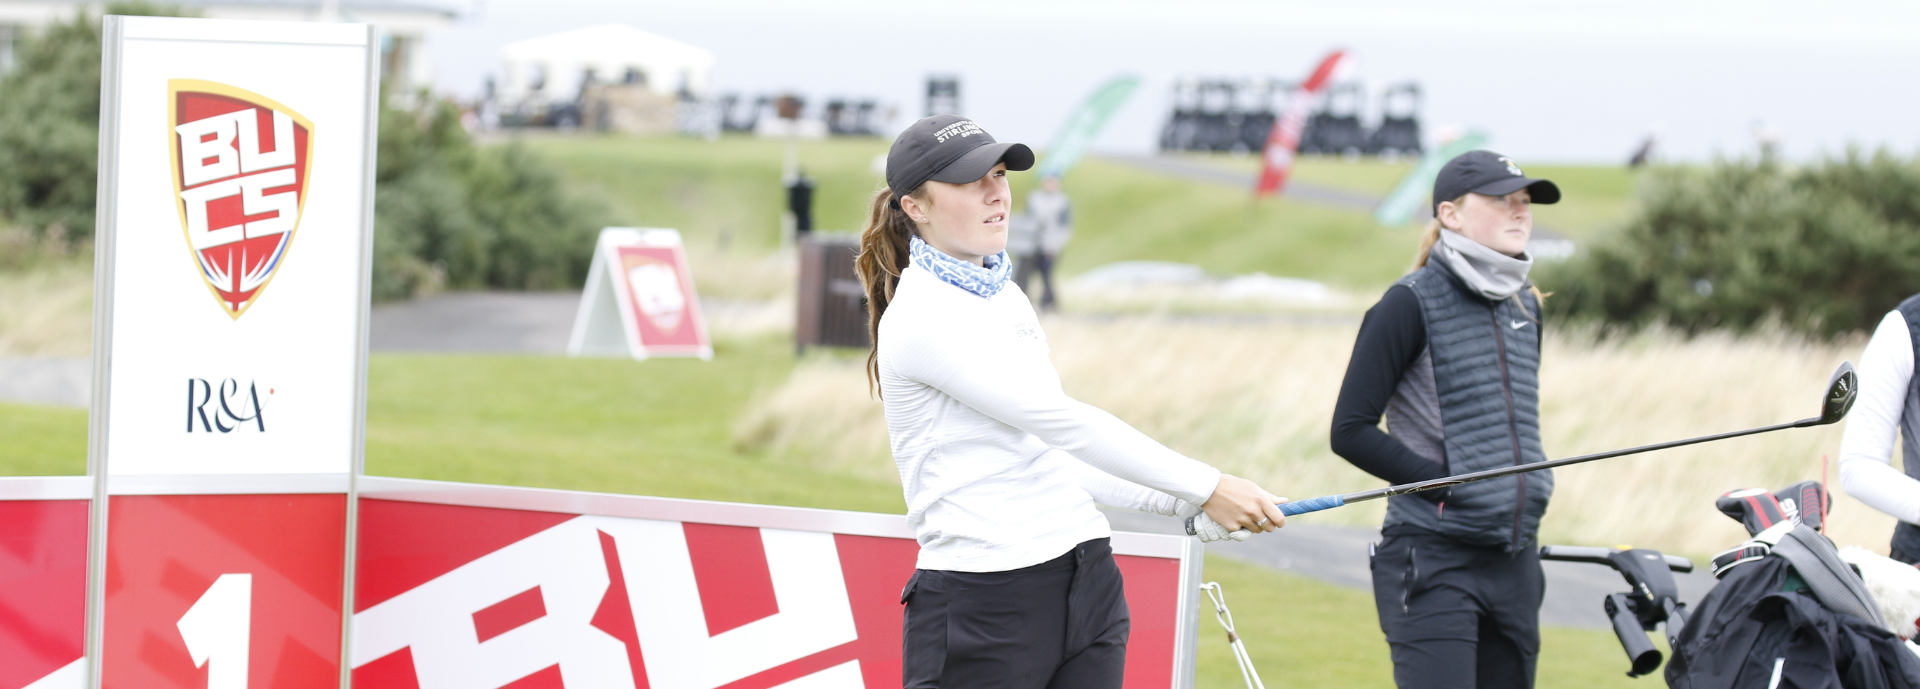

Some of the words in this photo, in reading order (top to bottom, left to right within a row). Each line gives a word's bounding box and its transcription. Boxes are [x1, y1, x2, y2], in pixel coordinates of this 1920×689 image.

[174, 108, 297, 187] BU
[179, 167, 299, 251] CS
[186, 377, 274, 433] R&A
[1780, 497, 1801, 529] ING
[176, 573, 252, 689] 1
